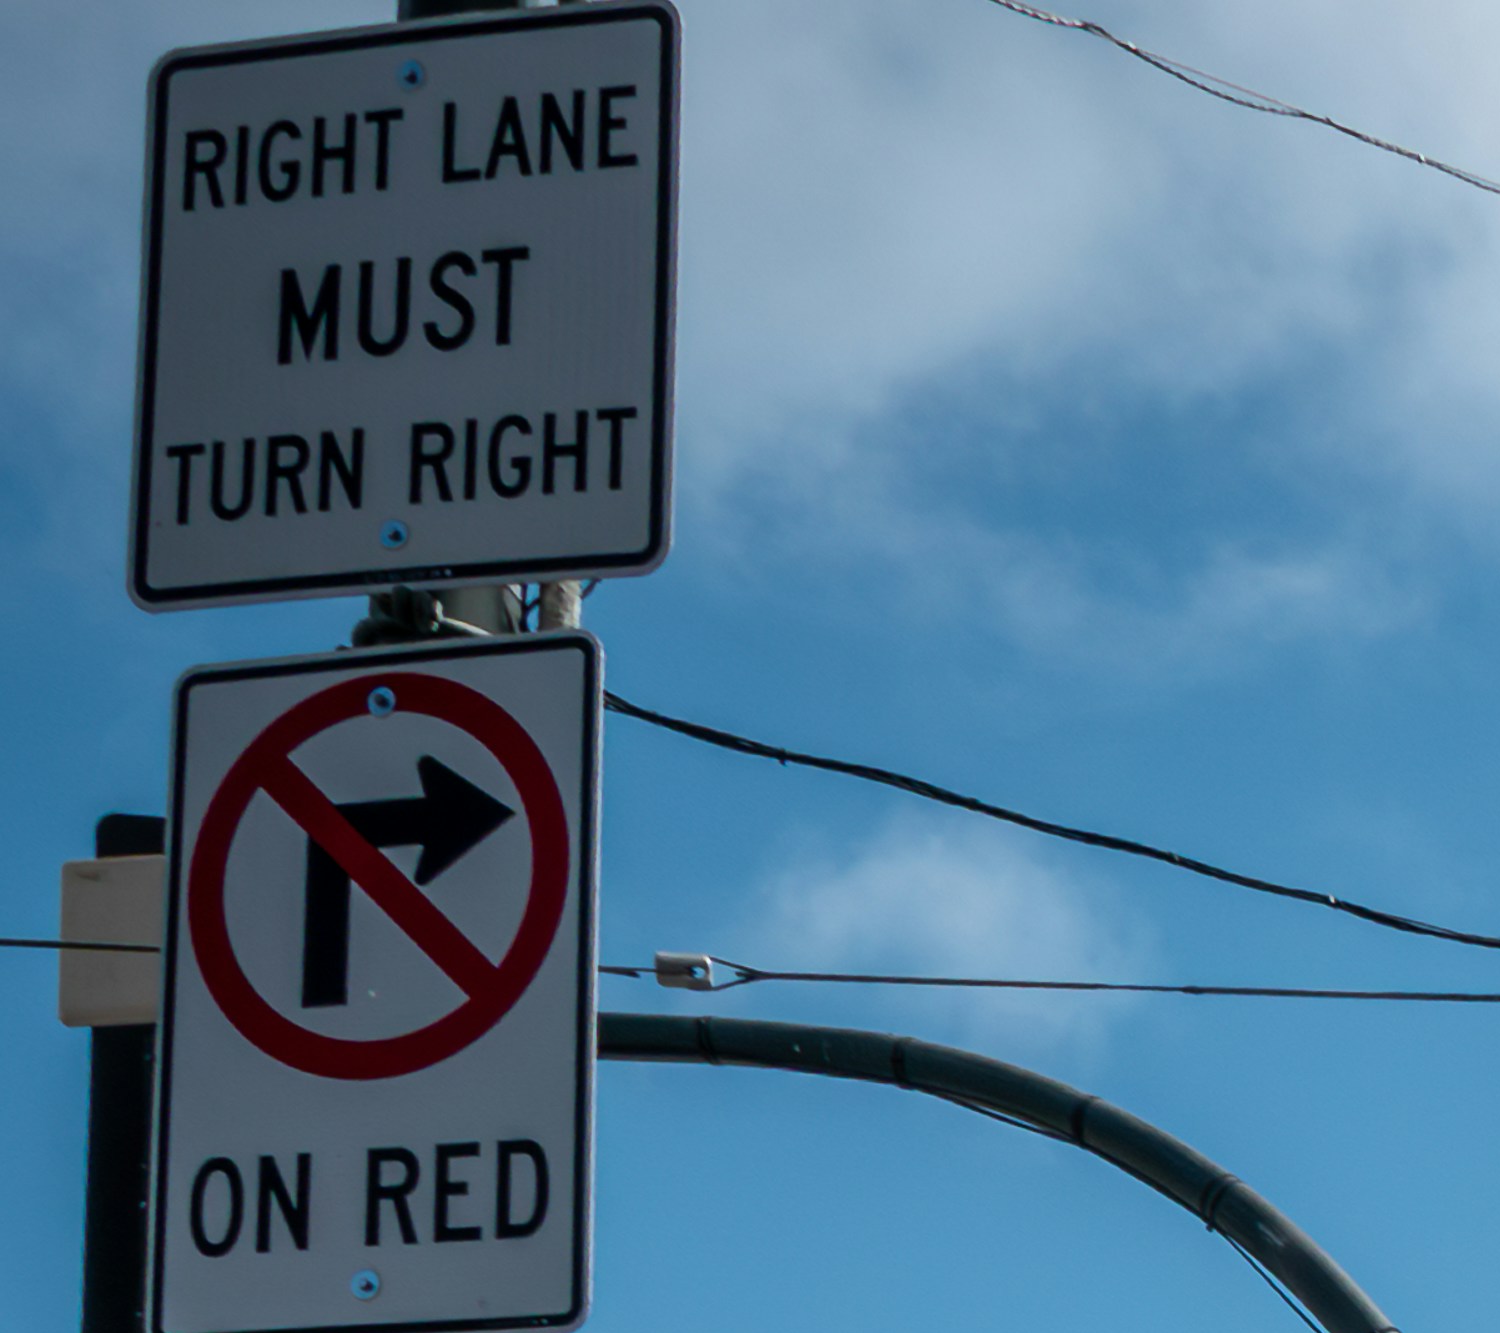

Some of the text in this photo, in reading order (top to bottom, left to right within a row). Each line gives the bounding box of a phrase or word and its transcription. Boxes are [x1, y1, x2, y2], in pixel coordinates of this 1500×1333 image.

[181, 84, 638, 212] RIGHT LANE
[277, 245, 530, 366] MUST
[166, 406, 638, 525] TURN RIGHT
[189, 1139, 550, 1258] ON RED
